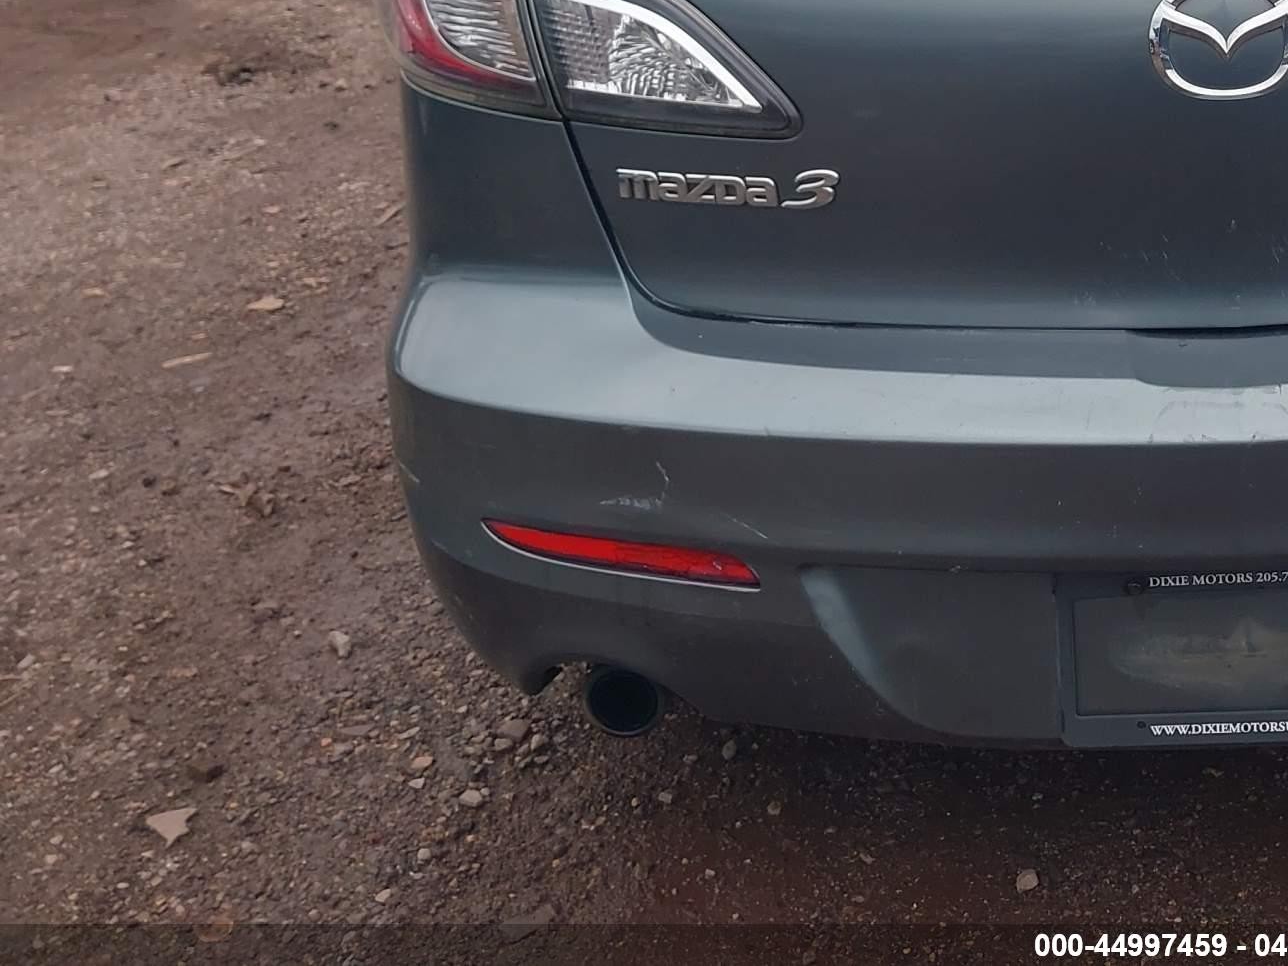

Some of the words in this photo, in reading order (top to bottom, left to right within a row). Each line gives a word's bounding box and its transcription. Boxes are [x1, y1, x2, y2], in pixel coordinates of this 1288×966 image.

[780, 168, 840, 209] 3
[1149, 576, 1190, 587] DIXIE
[1192, 572, 1253, 585] MOTORS
